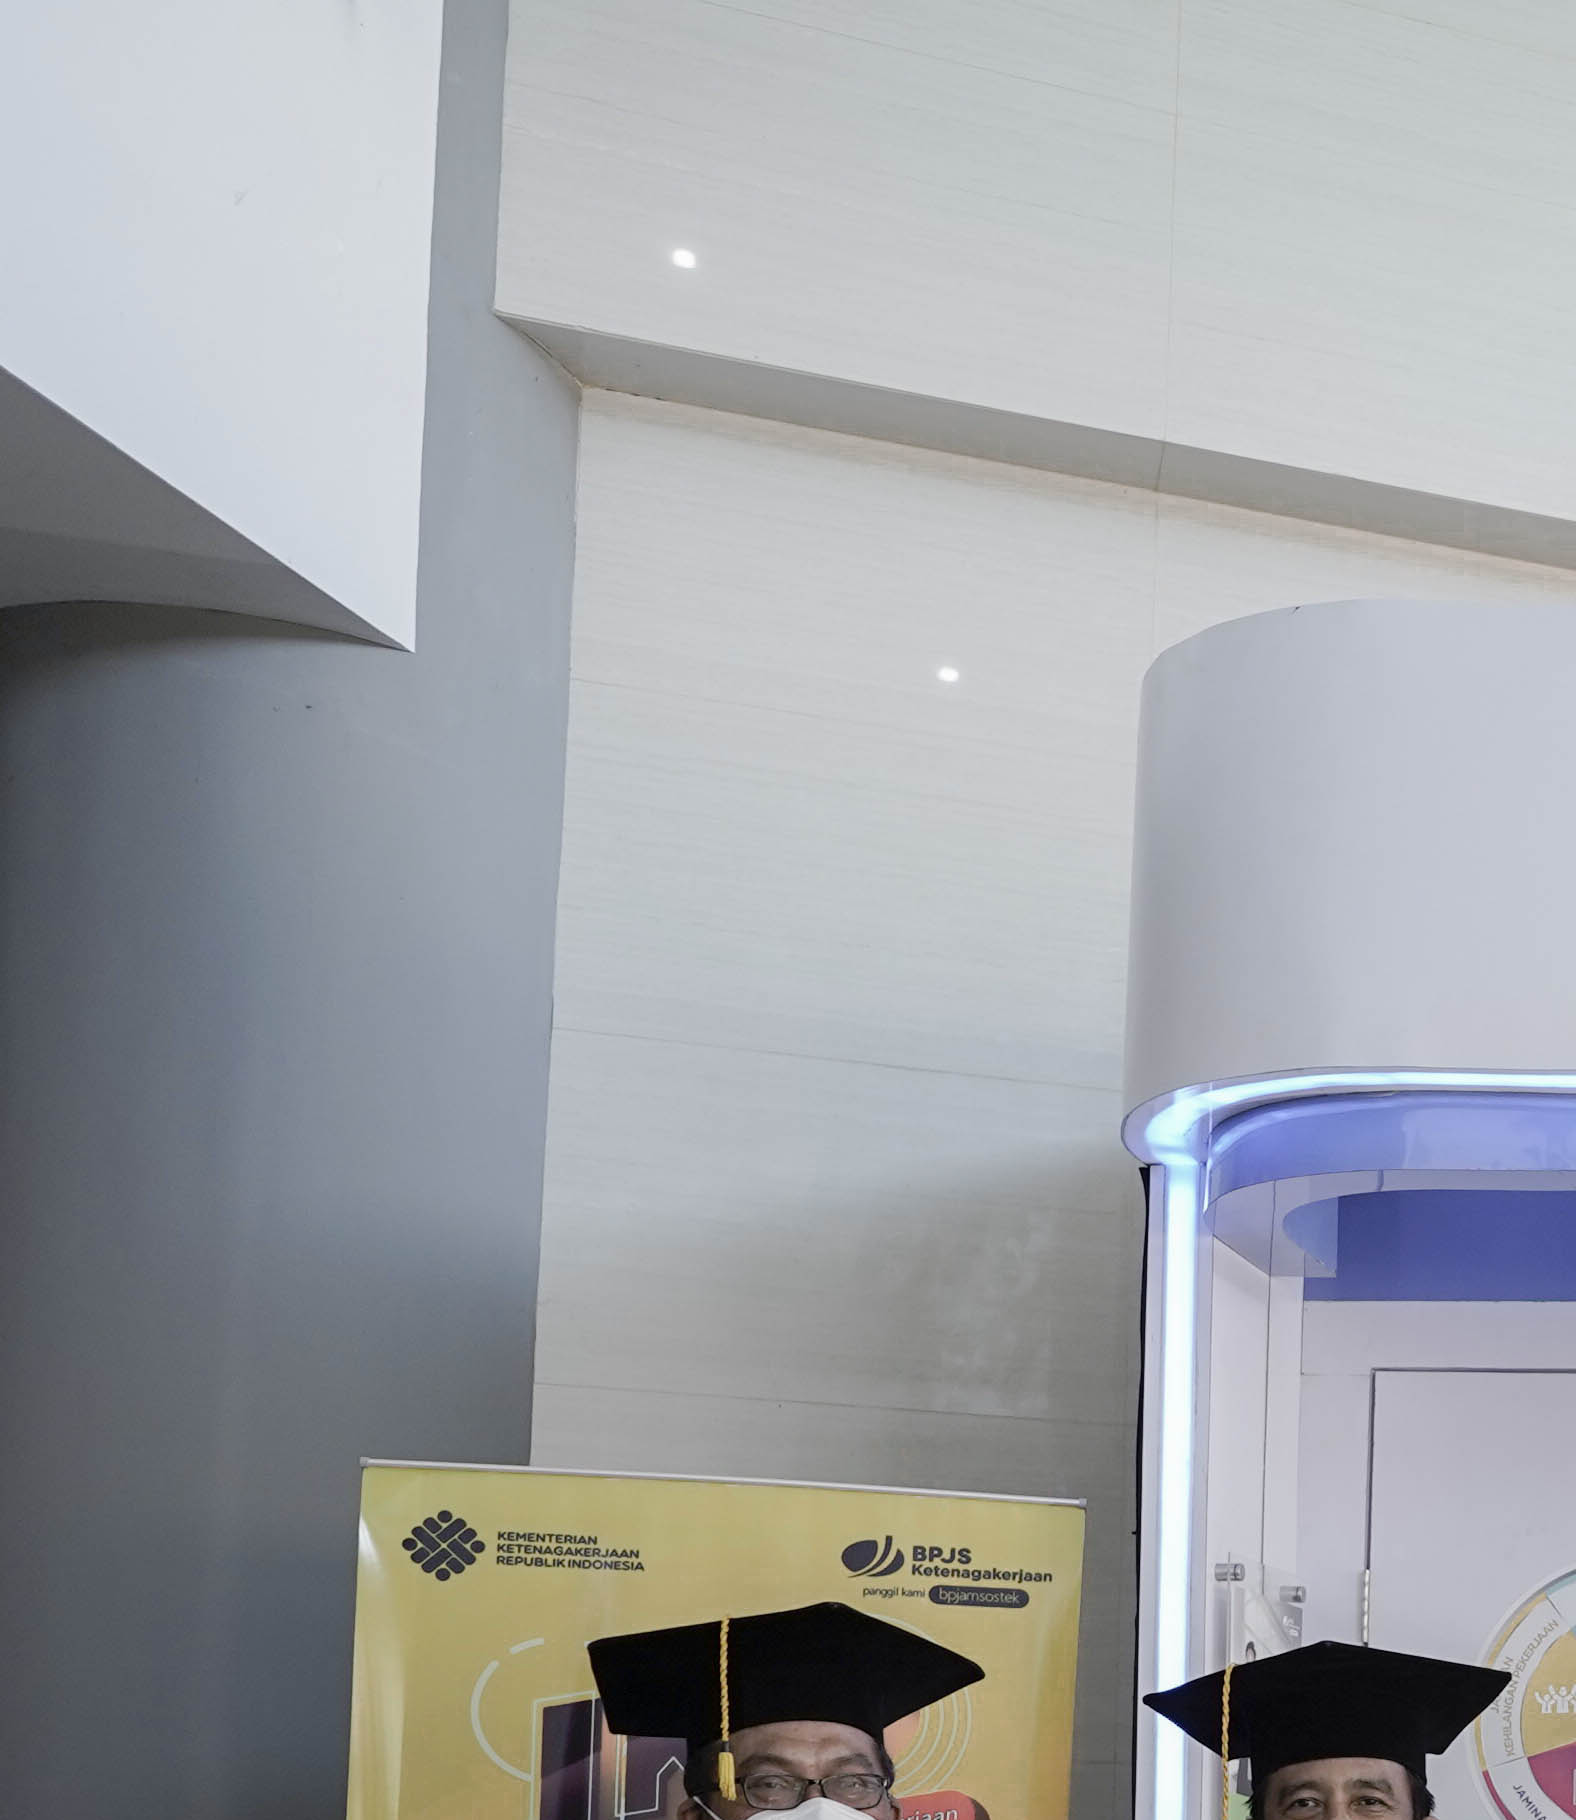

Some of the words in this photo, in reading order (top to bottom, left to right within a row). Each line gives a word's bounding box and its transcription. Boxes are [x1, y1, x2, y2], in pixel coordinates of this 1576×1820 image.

[497, 1531, 598, 1545] KEMENTERIAN
[496, 1543, 640, 1558] KETENAGAKERJAAN
[912, 1545, 972, 1564] BPJS
[496, 1555, 566, 1568] REPUBLIK
[568, 1559, 645, 1571] INDONESIA
[911, 1564, 1053, 1583] Ketenagakerjaan
[863, 1587, 898, 1599] panggil
[901, 1587, 926, 1598] kami
[938, 1588, 1021, 1604] bpjamsostek
